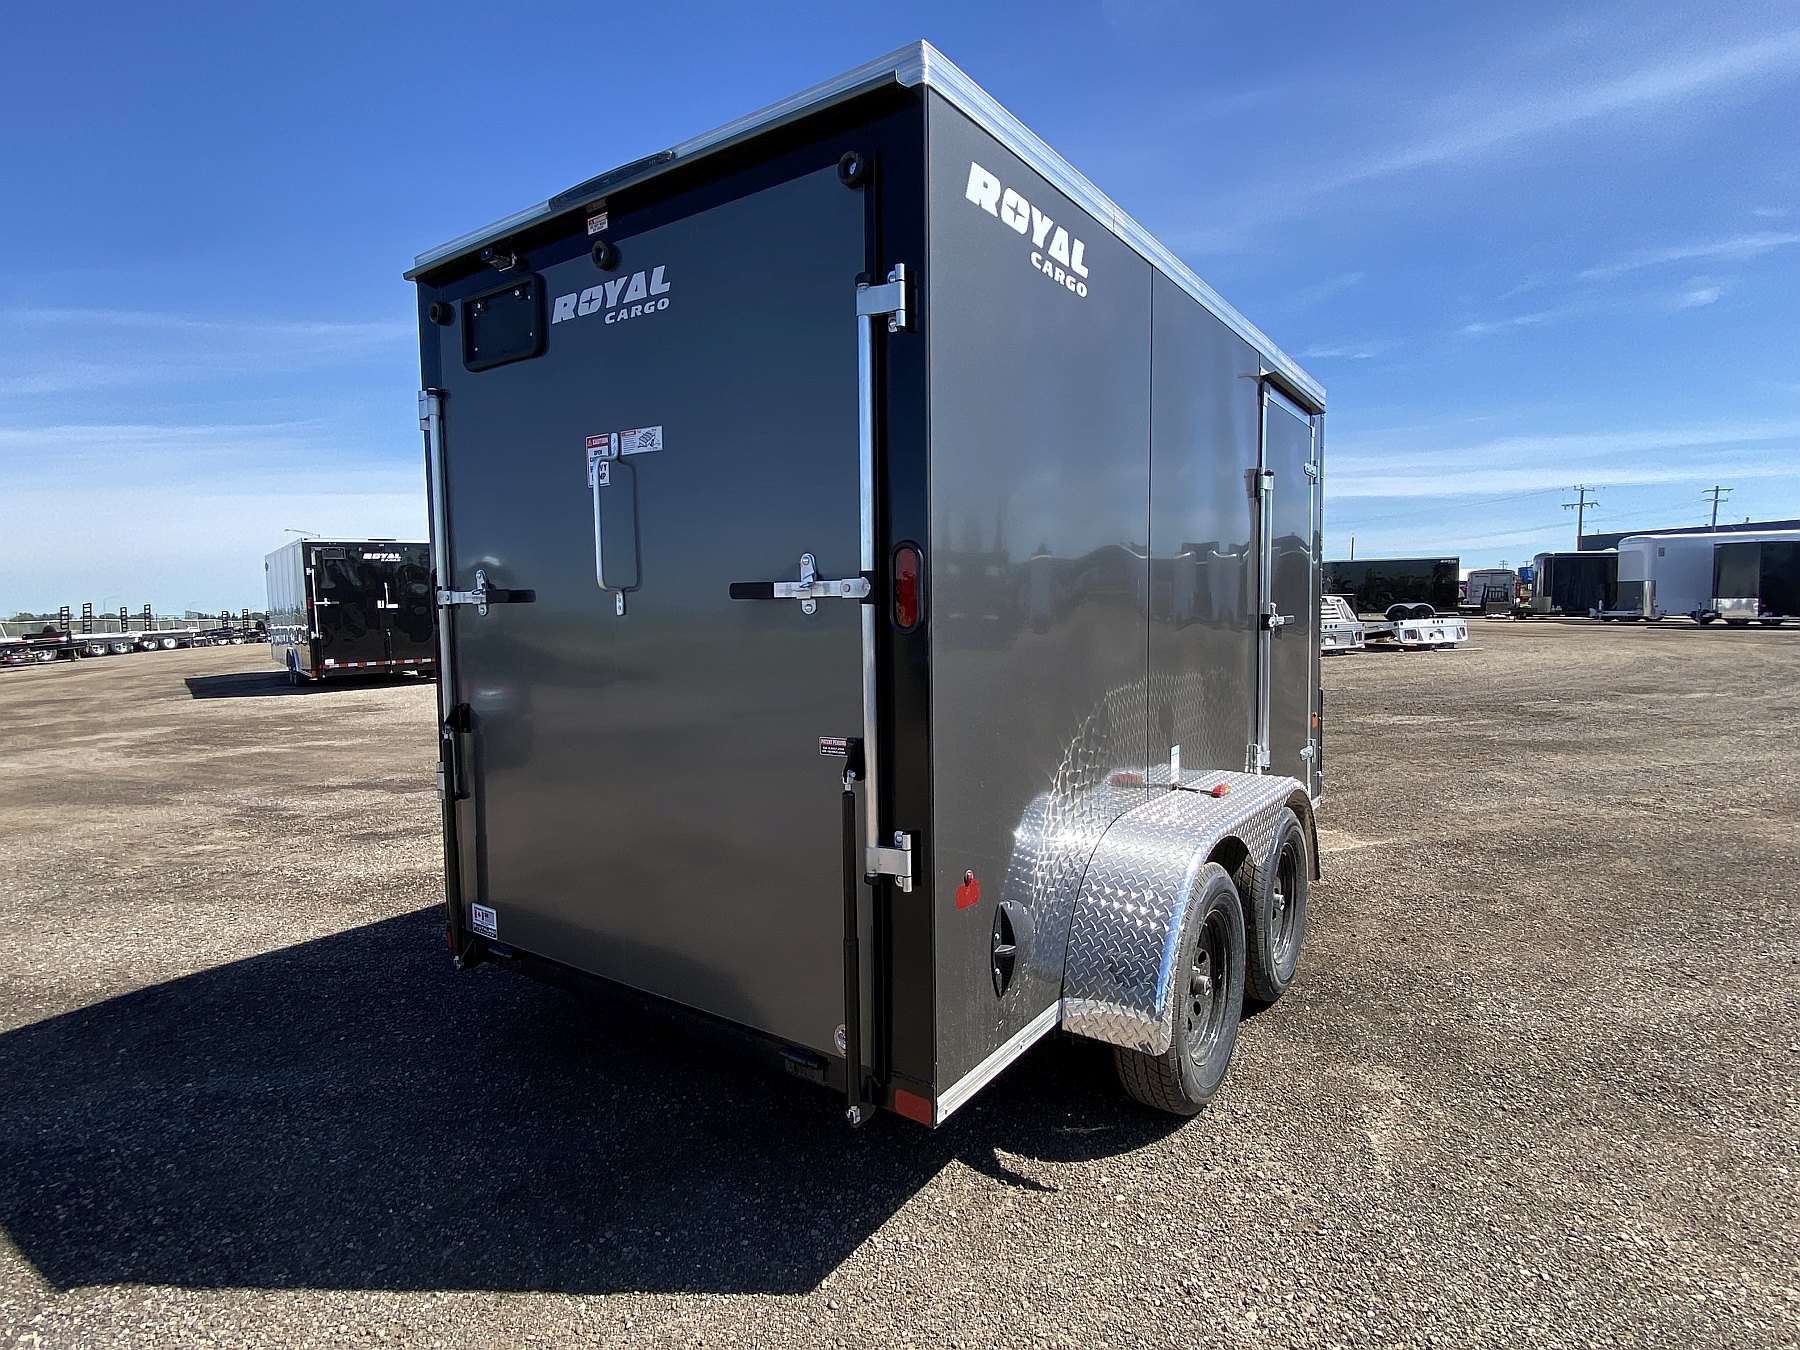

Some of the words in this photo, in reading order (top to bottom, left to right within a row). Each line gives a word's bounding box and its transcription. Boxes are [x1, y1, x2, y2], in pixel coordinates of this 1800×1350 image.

[965, 161, 1089, 279] ROYAL
[552, 265, 671, 324] ROYAL
[1030, 251, 1088, 298] CARGO
[604, 298, 670, 324] CARGO
